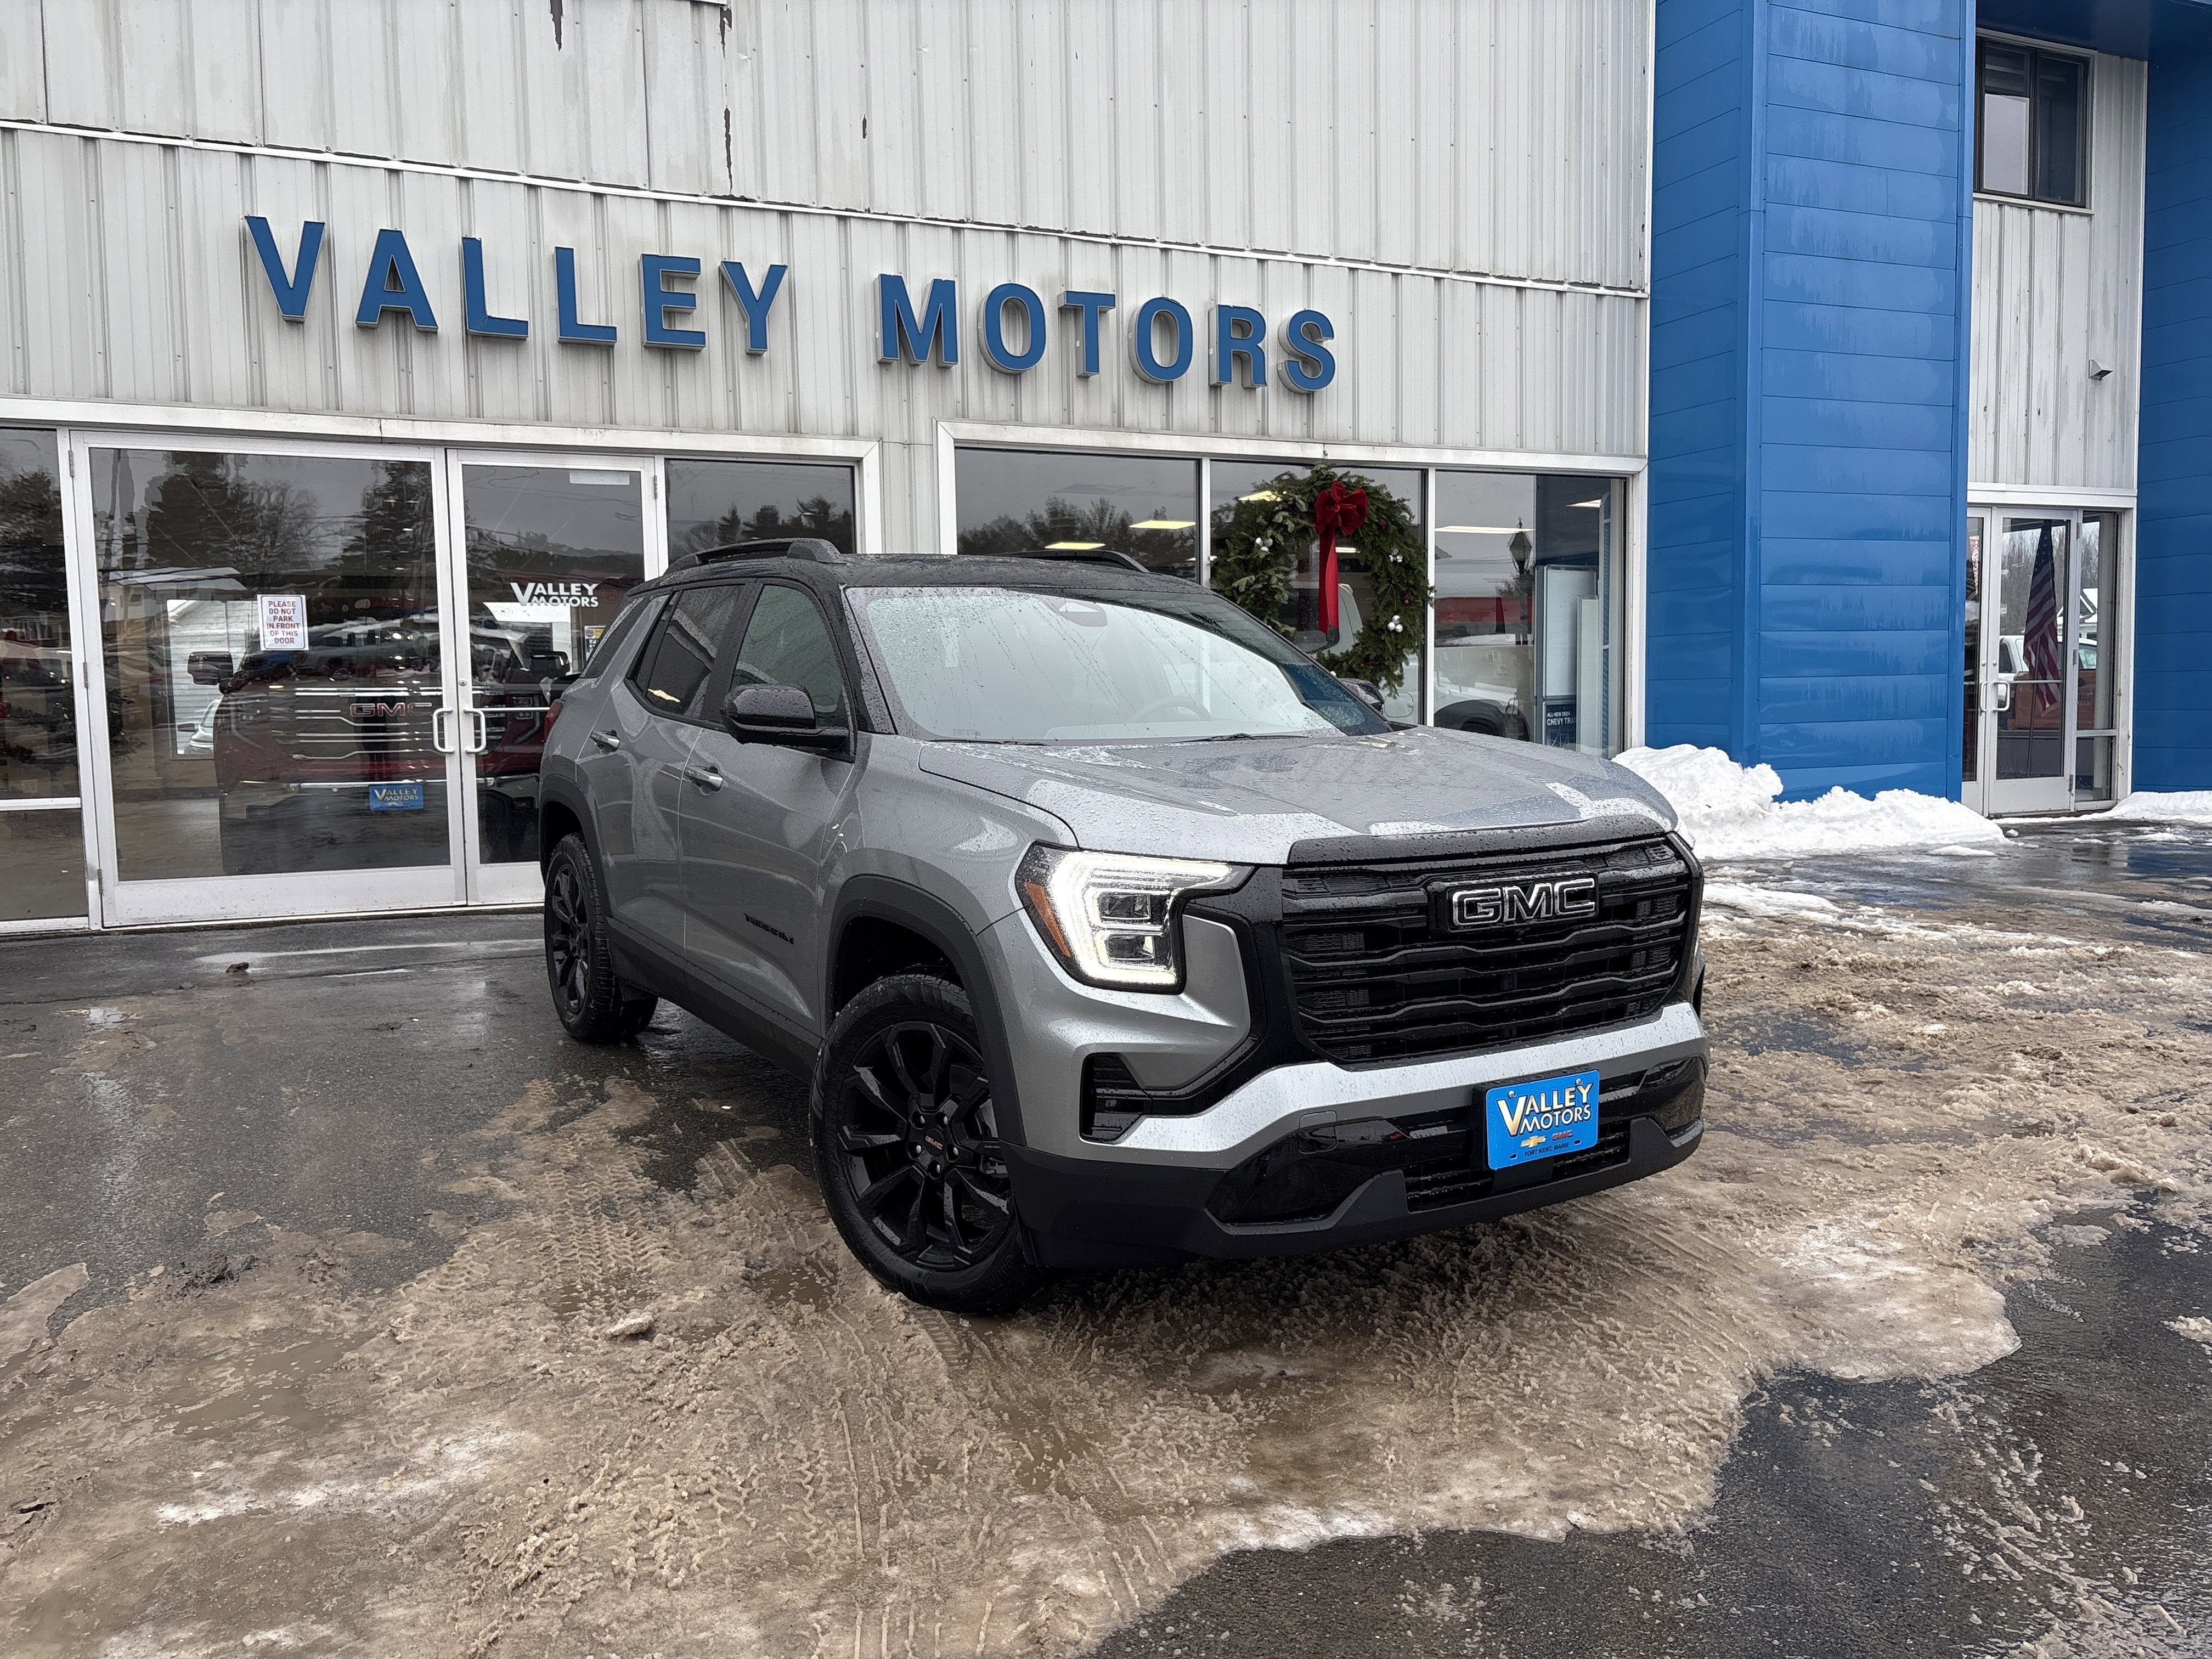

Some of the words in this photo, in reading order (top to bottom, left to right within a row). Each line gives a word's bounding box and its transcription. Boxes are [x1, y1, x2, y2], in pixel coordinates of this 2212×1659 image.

[244, 215, 789, 356] VALLEY
[877, 273, 1336, 394] MOTORS
[510, 582, 599, 606] VALLEY
[529, 596, 599, 607] MOTORS
[350, 702, 432, 717] GMC
[1547, 717, 1564, 726] CHEVY
[374, 788, 418, 801] VALLEY
[1453, 878, 1595, 926] GMC
[1497, 1082, 1594, 1137] VALLEY
[1519, 1104, 1592, 1134] MOTORS
[1552, 1129, 1573, 1141] GMC
[1554, 1142, 1570, 1150] MAINE
